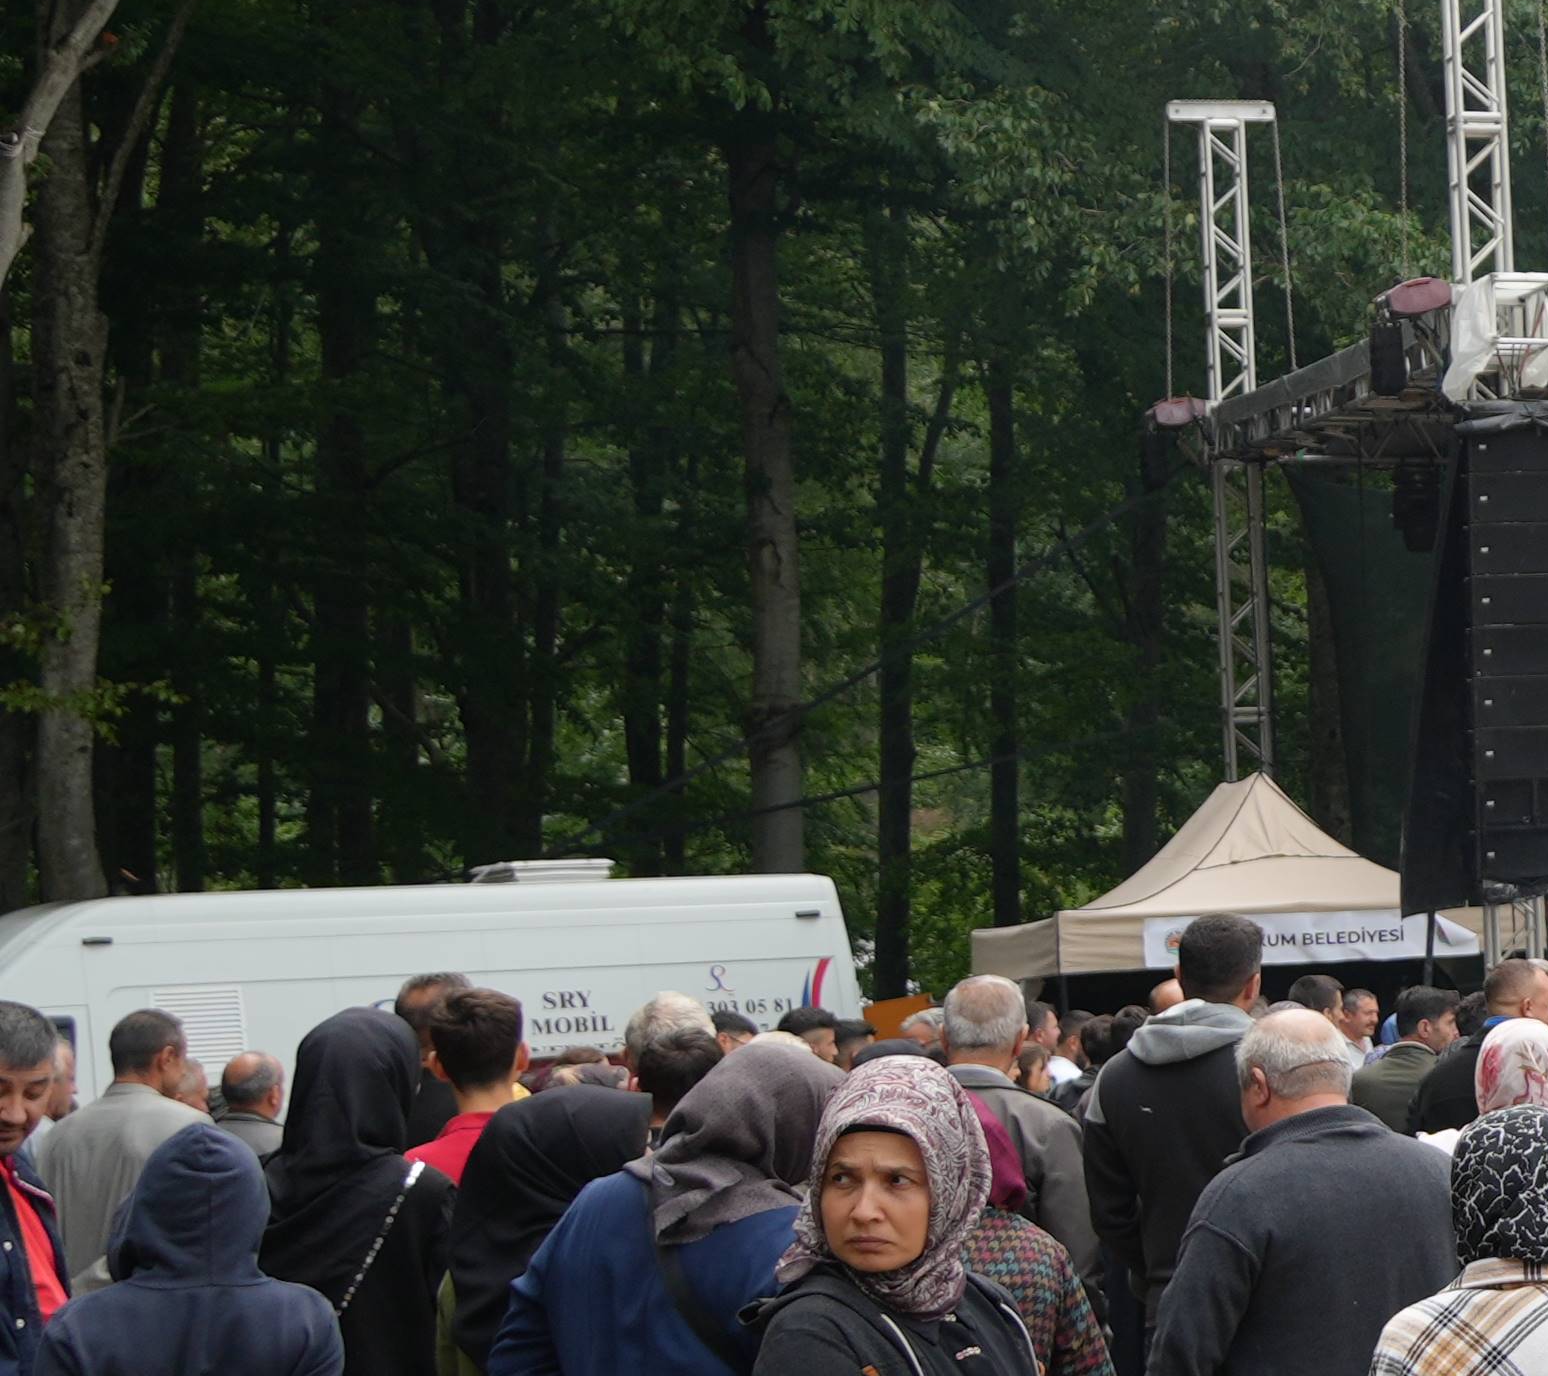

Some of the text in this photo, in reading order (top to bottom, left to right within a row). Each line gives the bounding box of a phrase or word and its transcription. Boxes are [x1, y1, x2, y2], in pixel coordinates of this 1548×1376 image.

[1302, 925, 1404, 946] BELEDİYESİ
[542, 990, 591, 1010] SRY
[746, 998, 767, 1015] 05
[530, 1010, 615, 1035] MOBİL
